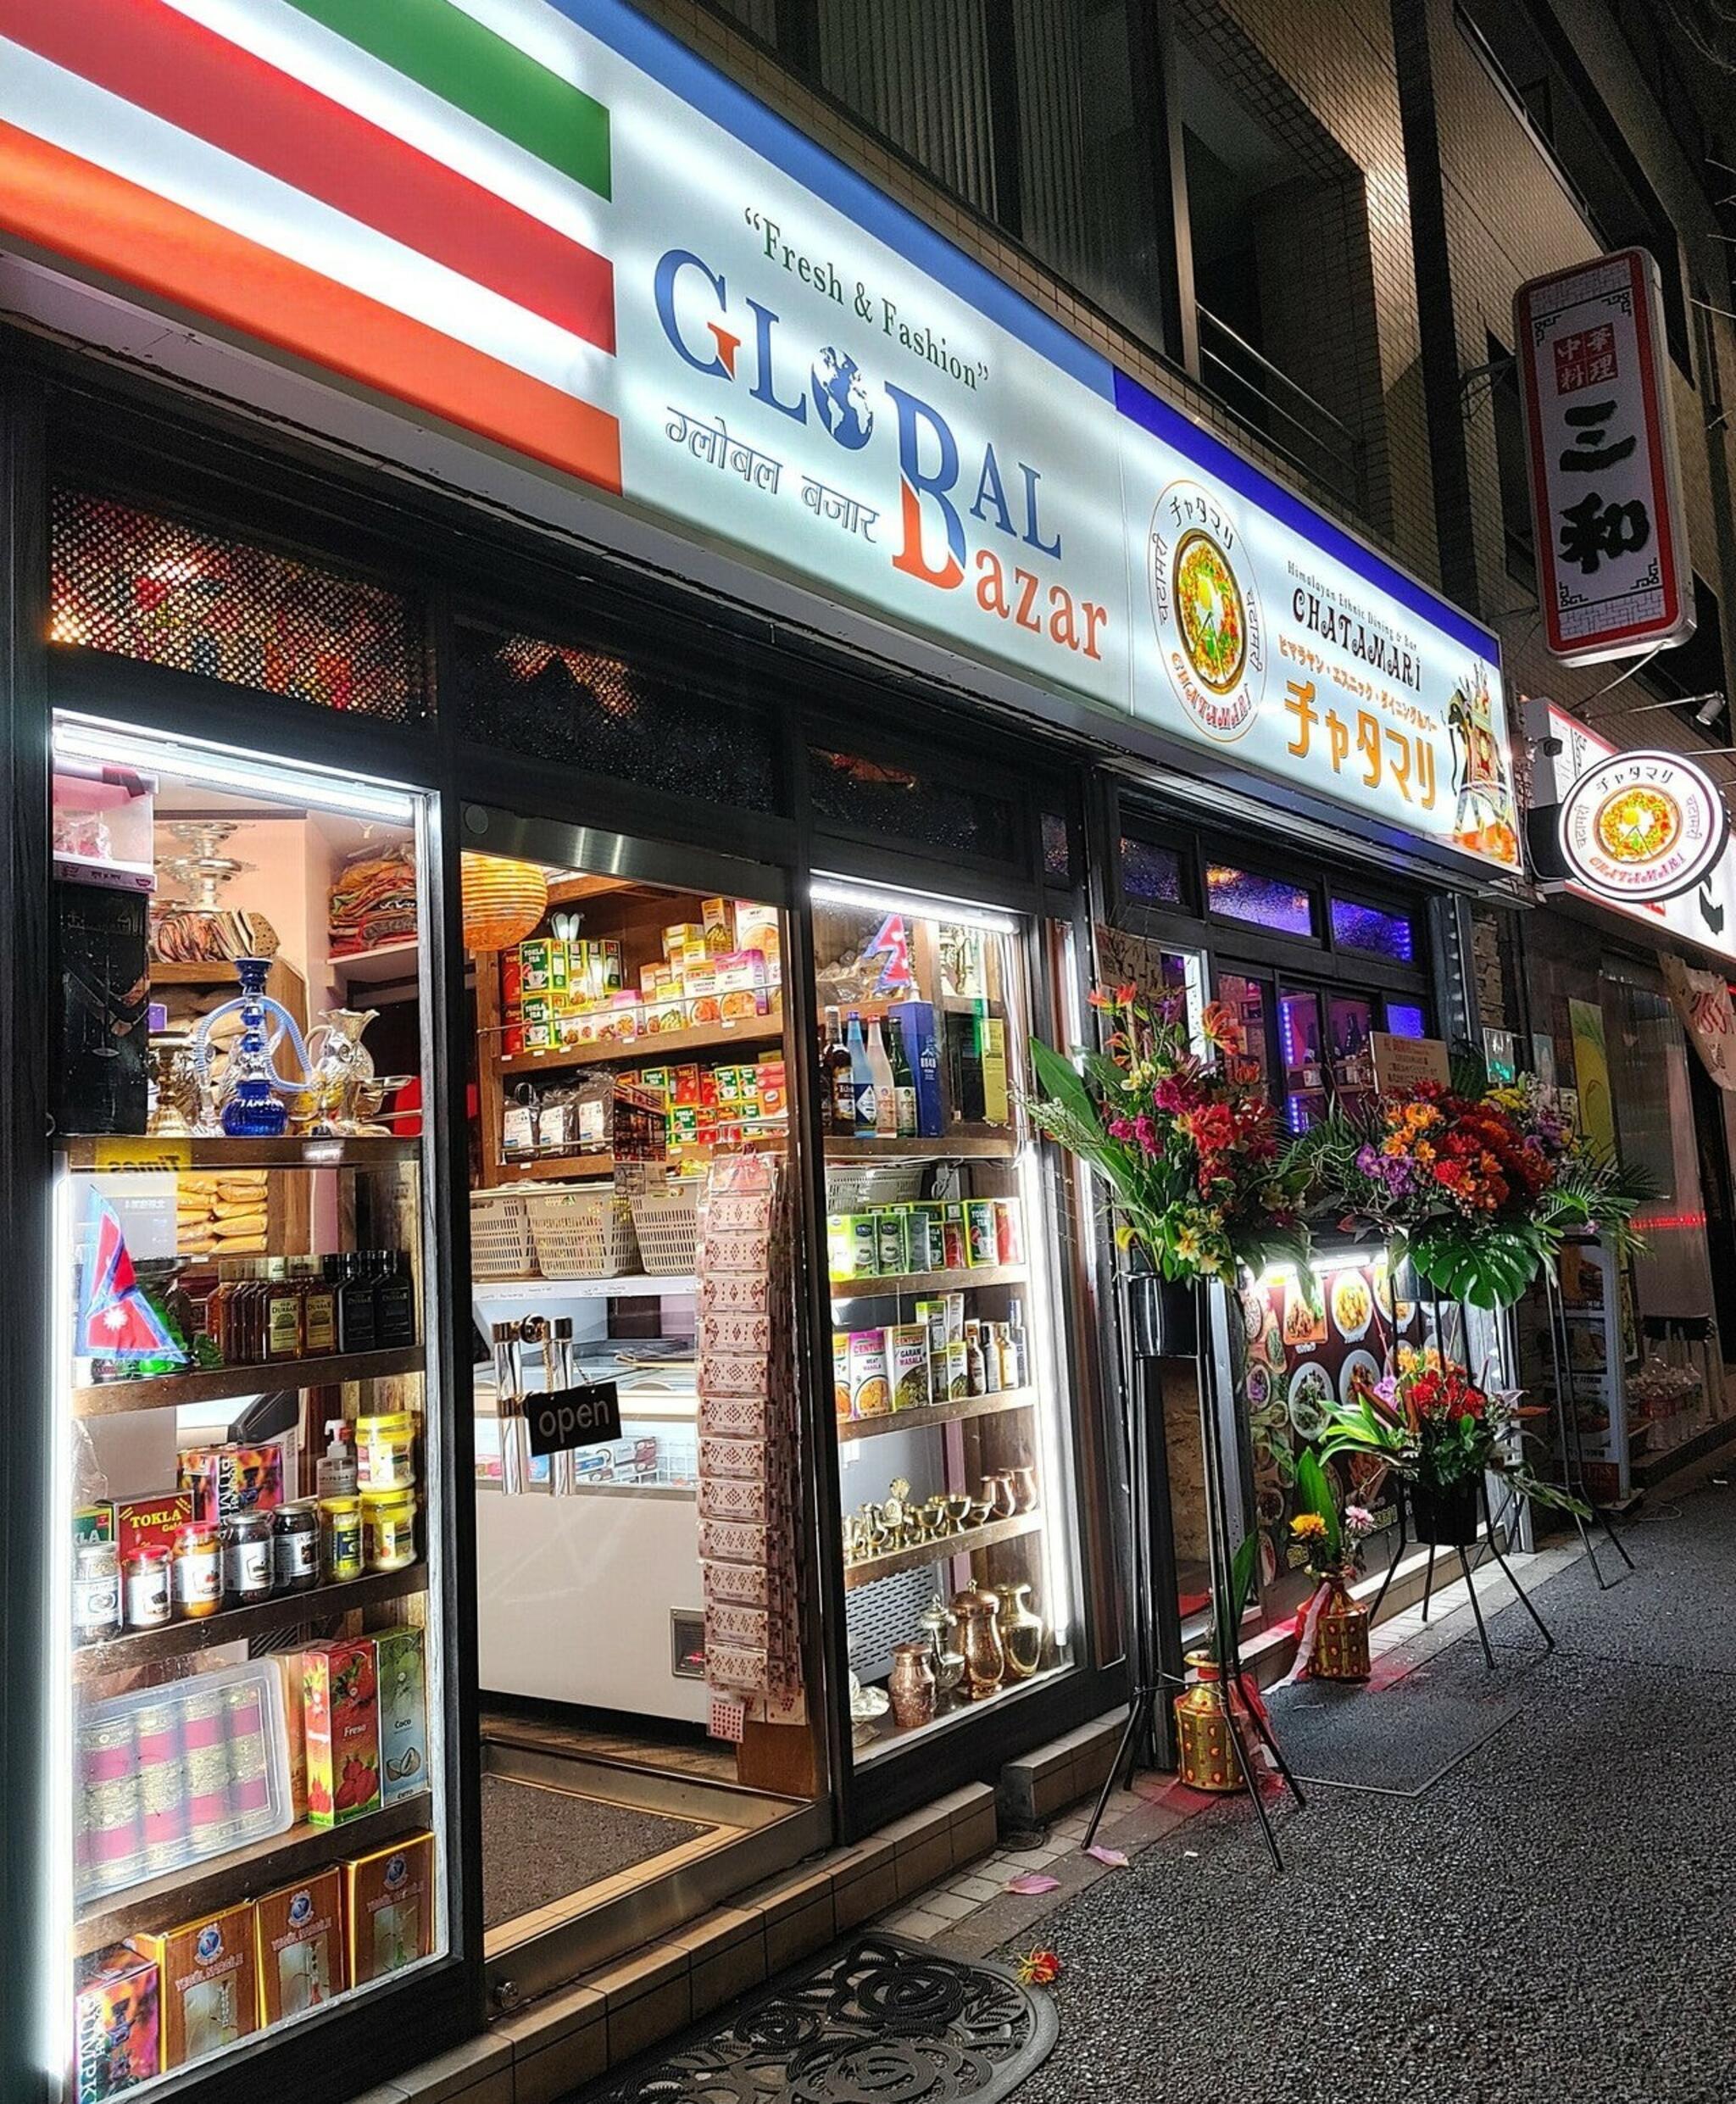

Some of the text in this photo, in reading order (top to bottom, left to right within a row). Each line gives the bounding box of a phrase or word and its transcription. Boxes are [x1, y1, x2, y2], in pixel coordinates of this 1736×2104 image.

[854, 281, 873, 323] &
[801, 475, 879, 544] बजार
[1558, 399, 1650, 575] 三和
[1170, 495, 1234, 550] チャタマリ
[1288, 560, 1335, 601] Himalayan
[1339, 593, 1365, 620] Ethnic
[1284, 680, 1436, 811] チャタマリ
[538, 1400, 610, 1444] open
[130, 1509, 183, 1528] TOKLA
[394, 1718, 412, 1729] Coco
